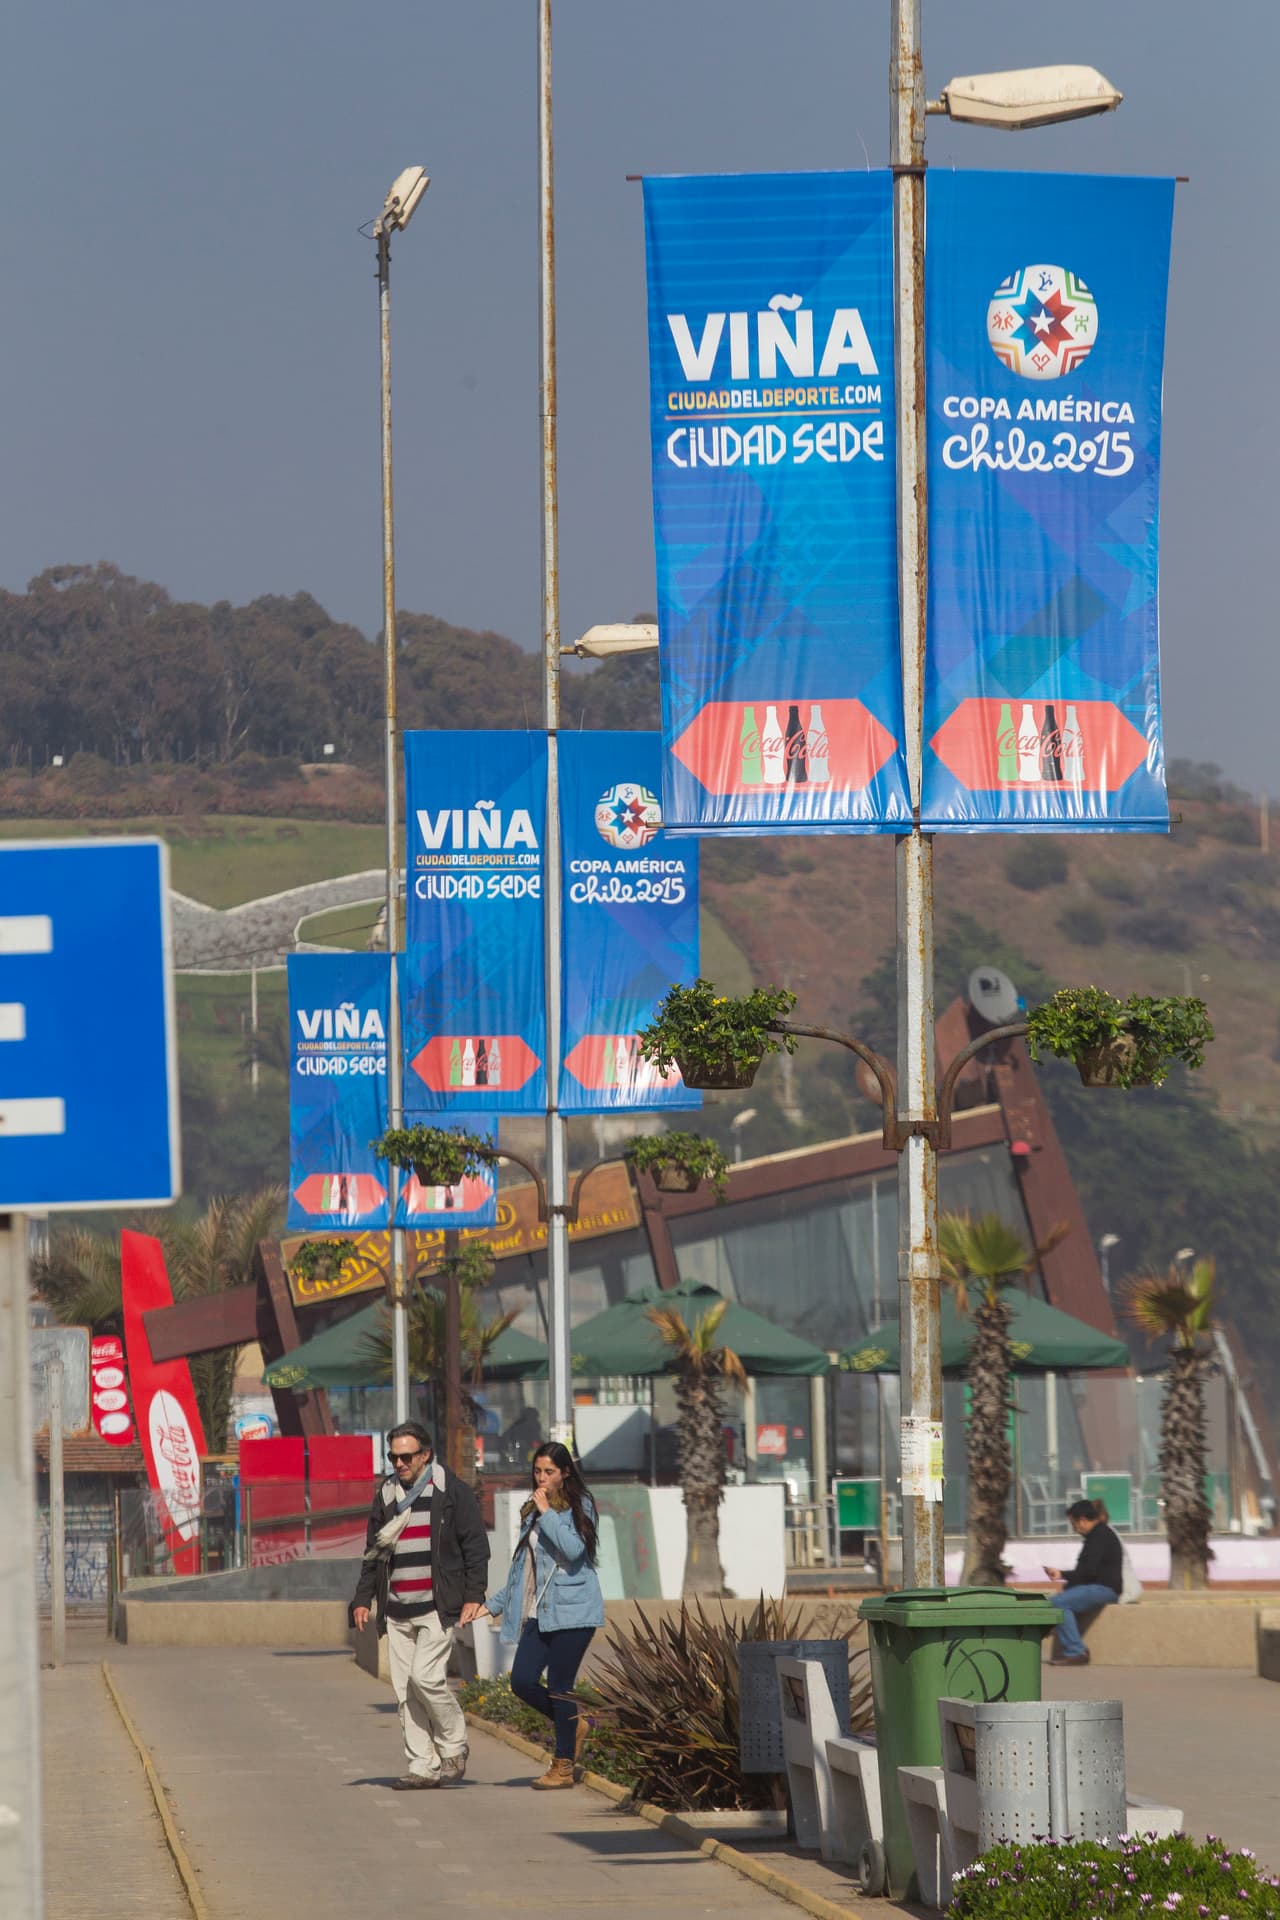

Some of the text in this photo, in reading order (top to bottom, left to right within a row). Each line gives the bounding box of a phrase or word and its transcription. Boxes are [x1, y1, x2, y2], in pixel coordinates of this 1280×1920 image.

[667, 293, 880, 381] VIÑA
[667, 385, 882, 410] CIUDADDELDEPORTE.COM
[943, 394, 1135, 424] COPA AMÉRICA
[942, 422, 1135, 477] Chile 2015
[416, 800, 539, 849] VIÑA
[416, 854, 540, 865] CIUDADDELDEPORTE.COM
[570, 857, 685, 873] COPA AMÉRICA
[570, 875, 686, 904] Chile 2015
[297, 1002, 385, 1039] VIÑA
